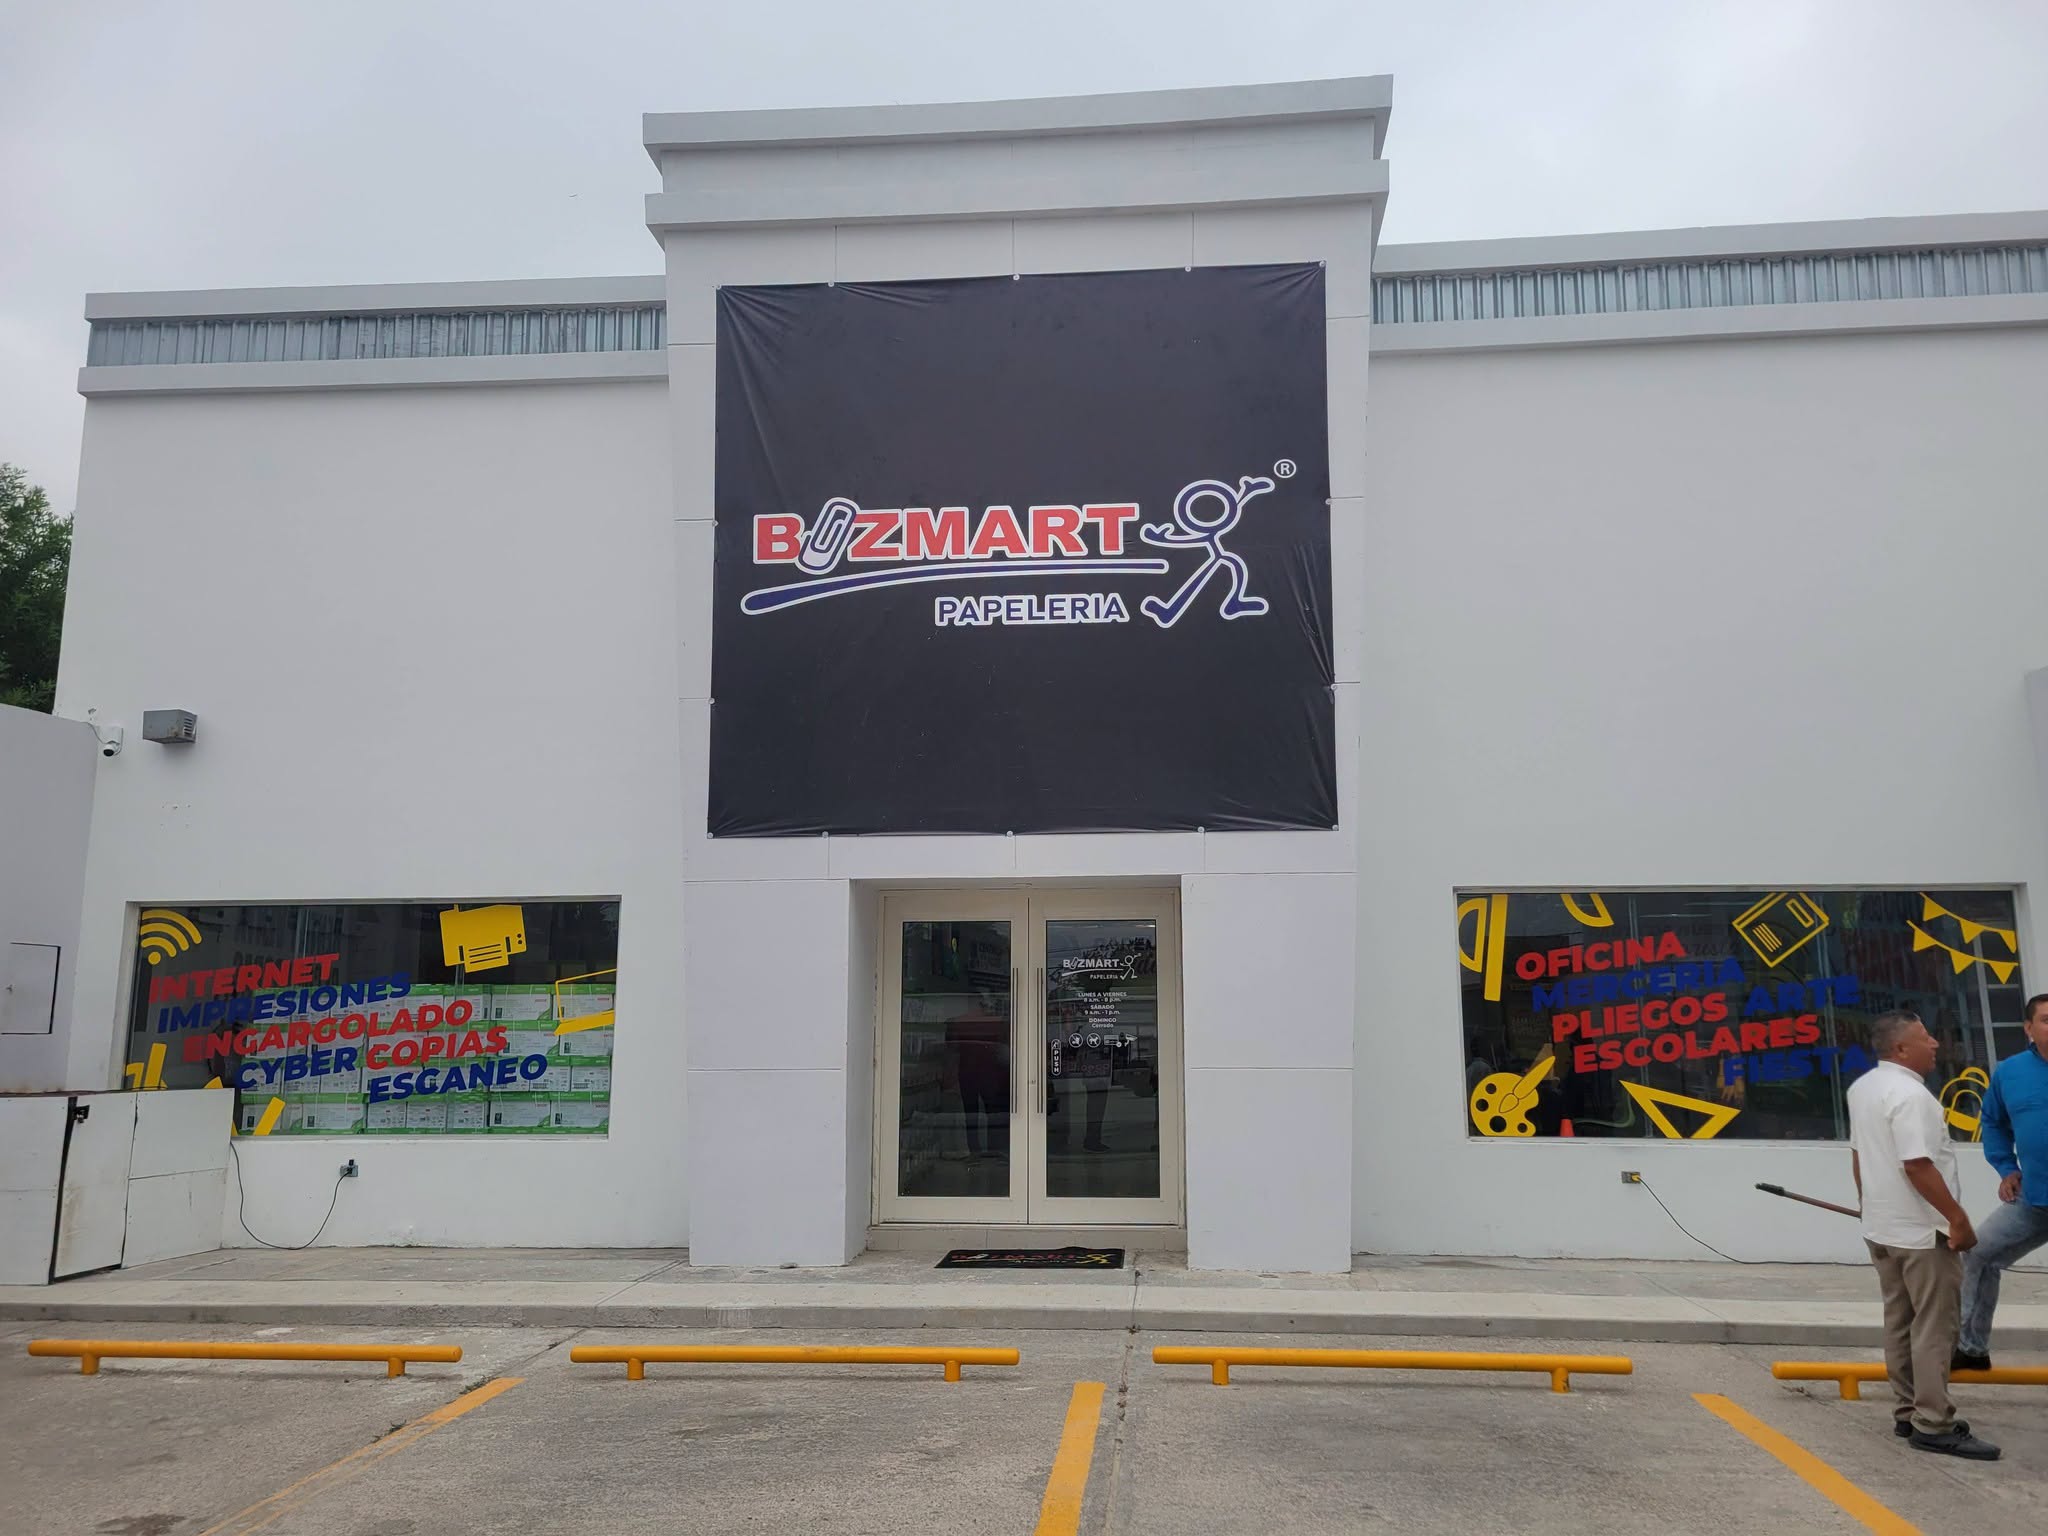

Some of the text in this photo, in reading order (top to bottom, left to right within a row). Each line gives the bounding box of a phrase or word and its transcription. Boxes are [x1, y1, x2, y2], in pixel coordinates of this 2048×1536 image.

[935, 592, 1130, 626] PAPELERIA
[147, 953, 340, 1004] INTERNET
[1515, 931, 1687, 981] OFICINA
[157, 972, 412, 1033] IMPRESIONES
[1530, 957, 1746, 1013] MERCERIA
[1743, 975, 1862, 1017] ARTE
[182, 999, 473, 1063] ENGARGOLADO
[1551, 992, 1728, 1043] PLIEGOS
[235, 1026, 509, 1089] CYBER COPIAS
[1573, 1014, 1821, 1074] ESCOLARES
[1724, 1043, 1880, 1086] FIESTA
[368, 1054, 549, 1104] ESCANEO
